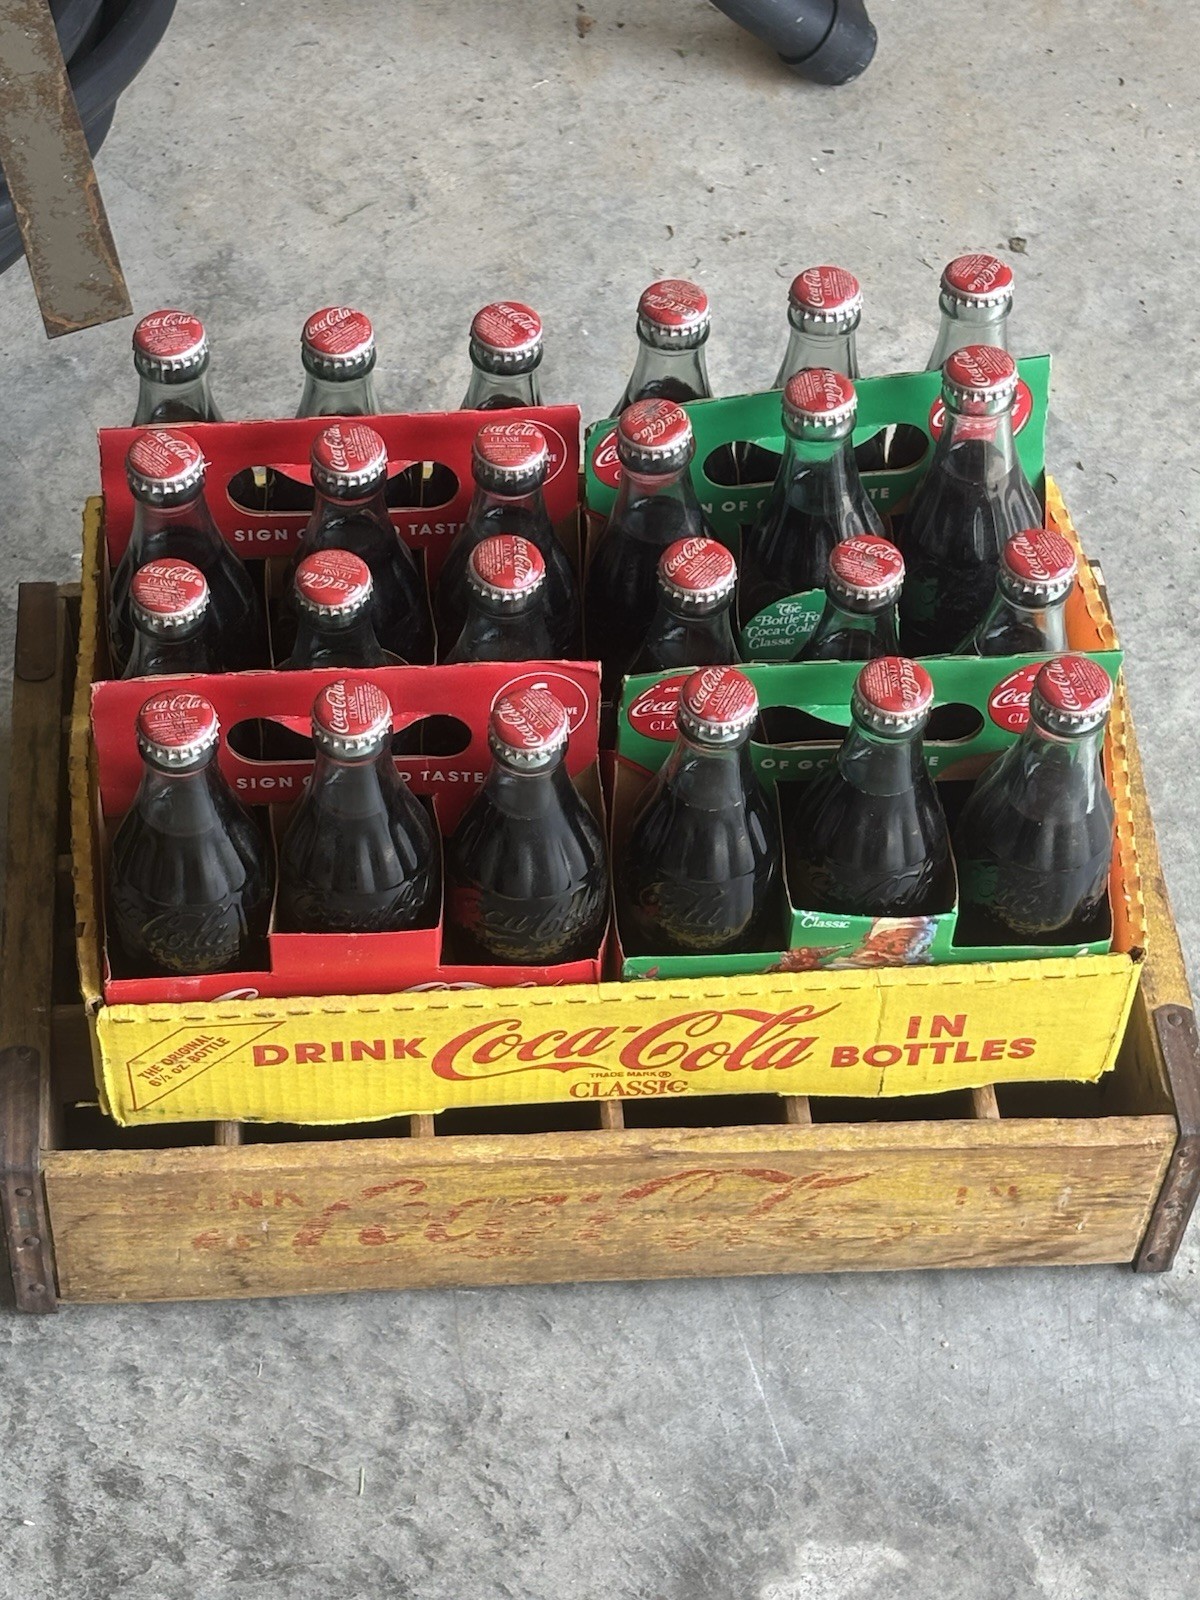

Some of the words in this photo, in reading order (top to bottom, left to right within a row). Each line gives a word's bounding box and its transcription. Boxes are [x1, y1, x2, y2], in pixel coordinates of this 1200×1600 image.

[305, 307, 352, 340] Coca-Cola
[722, 501, 748, 512] OF
[234, 528, 289, 542] SIGN
[408, 523, 465, 536] TAST
[665, 537, 709, 577] Coca-Cola
[839, 540, 898, 561] Coca-Cola
[137, 565, 200, 583] Coca-Cola
[755, 614, 801, 626] Bottle
[800, 611, 820, 622] Fo
[776, 602, 802, 616] The
[745, 622, 815, 638] Coca-Cola
[748, 637, 795, 649] Classic
[140, 694, 202, 716] Coca-Cola
[326, 679, 350, 734] Coca-Cola
[155, 710, 187, 720] CLASSIC
[760, 758, 790, 770] OF
[237, 777, 293, 789] SIGN
[421, 771, 484, 783] TASTE
[801, 916, 851, 929] Classic
[906, 1014, 968, 1039] IN
[187, 1037, 231, 1062] BOTTLE
[431, 1002, 842, 1081] Coca-Cola
[137, 1064, 164, 1079] THE
[161, 1035, 214, 1065] ORIGINAL
[252, 1037, 428, 1067] DRINK
[830, 1038, 1037, 1067] BOTTLES
[569, 1080, 689, 1098] CLASSIC
